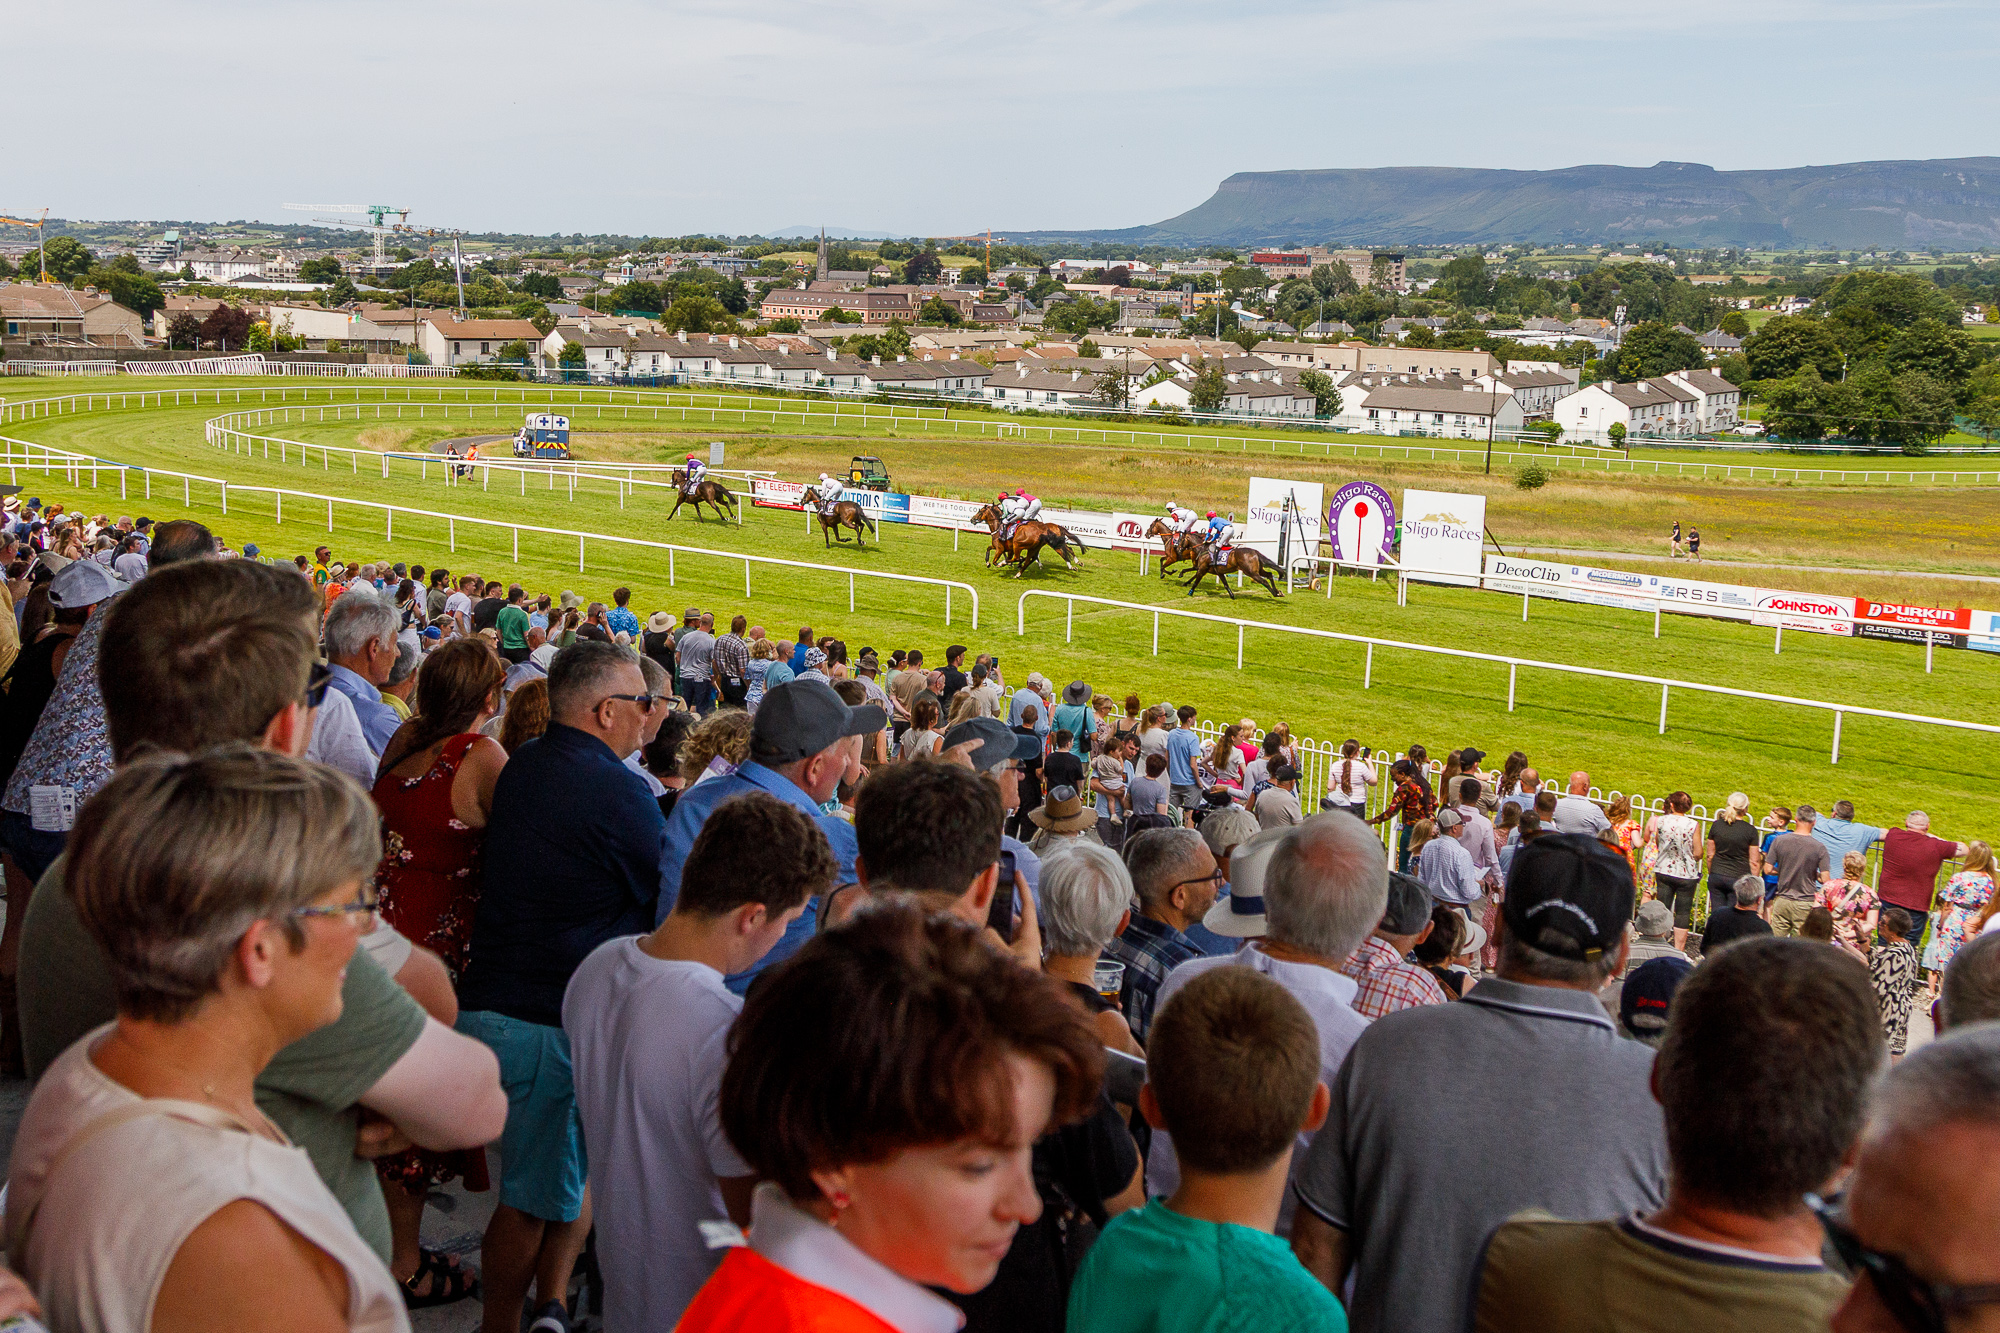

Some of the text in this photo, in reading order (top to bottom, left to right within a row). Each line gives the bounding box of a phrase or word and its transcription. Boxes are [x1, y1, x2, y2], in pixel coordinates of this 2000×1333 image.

[769, 482, 803, 494] ELECTRIC
[937, 502, 948, 510] THE
[950, 504, 967, 512] TOOL
[1332, 484, 1393, 517] Sligo Races
[1250, 507, 1319, 527] Sligo aces
[1404, 520, 1481, 541] Sligo Races
[1220, 552, 1228, 562] 8
[1495, 561, 1561, 582] DecoClip
[1676, 587, 1718, 602] RSS
[1768, 599, 1838, 616] JOHNSTON
[1883, 604, 1955, 621] DURKIN
[1896, 615, 1920, 623] bros
